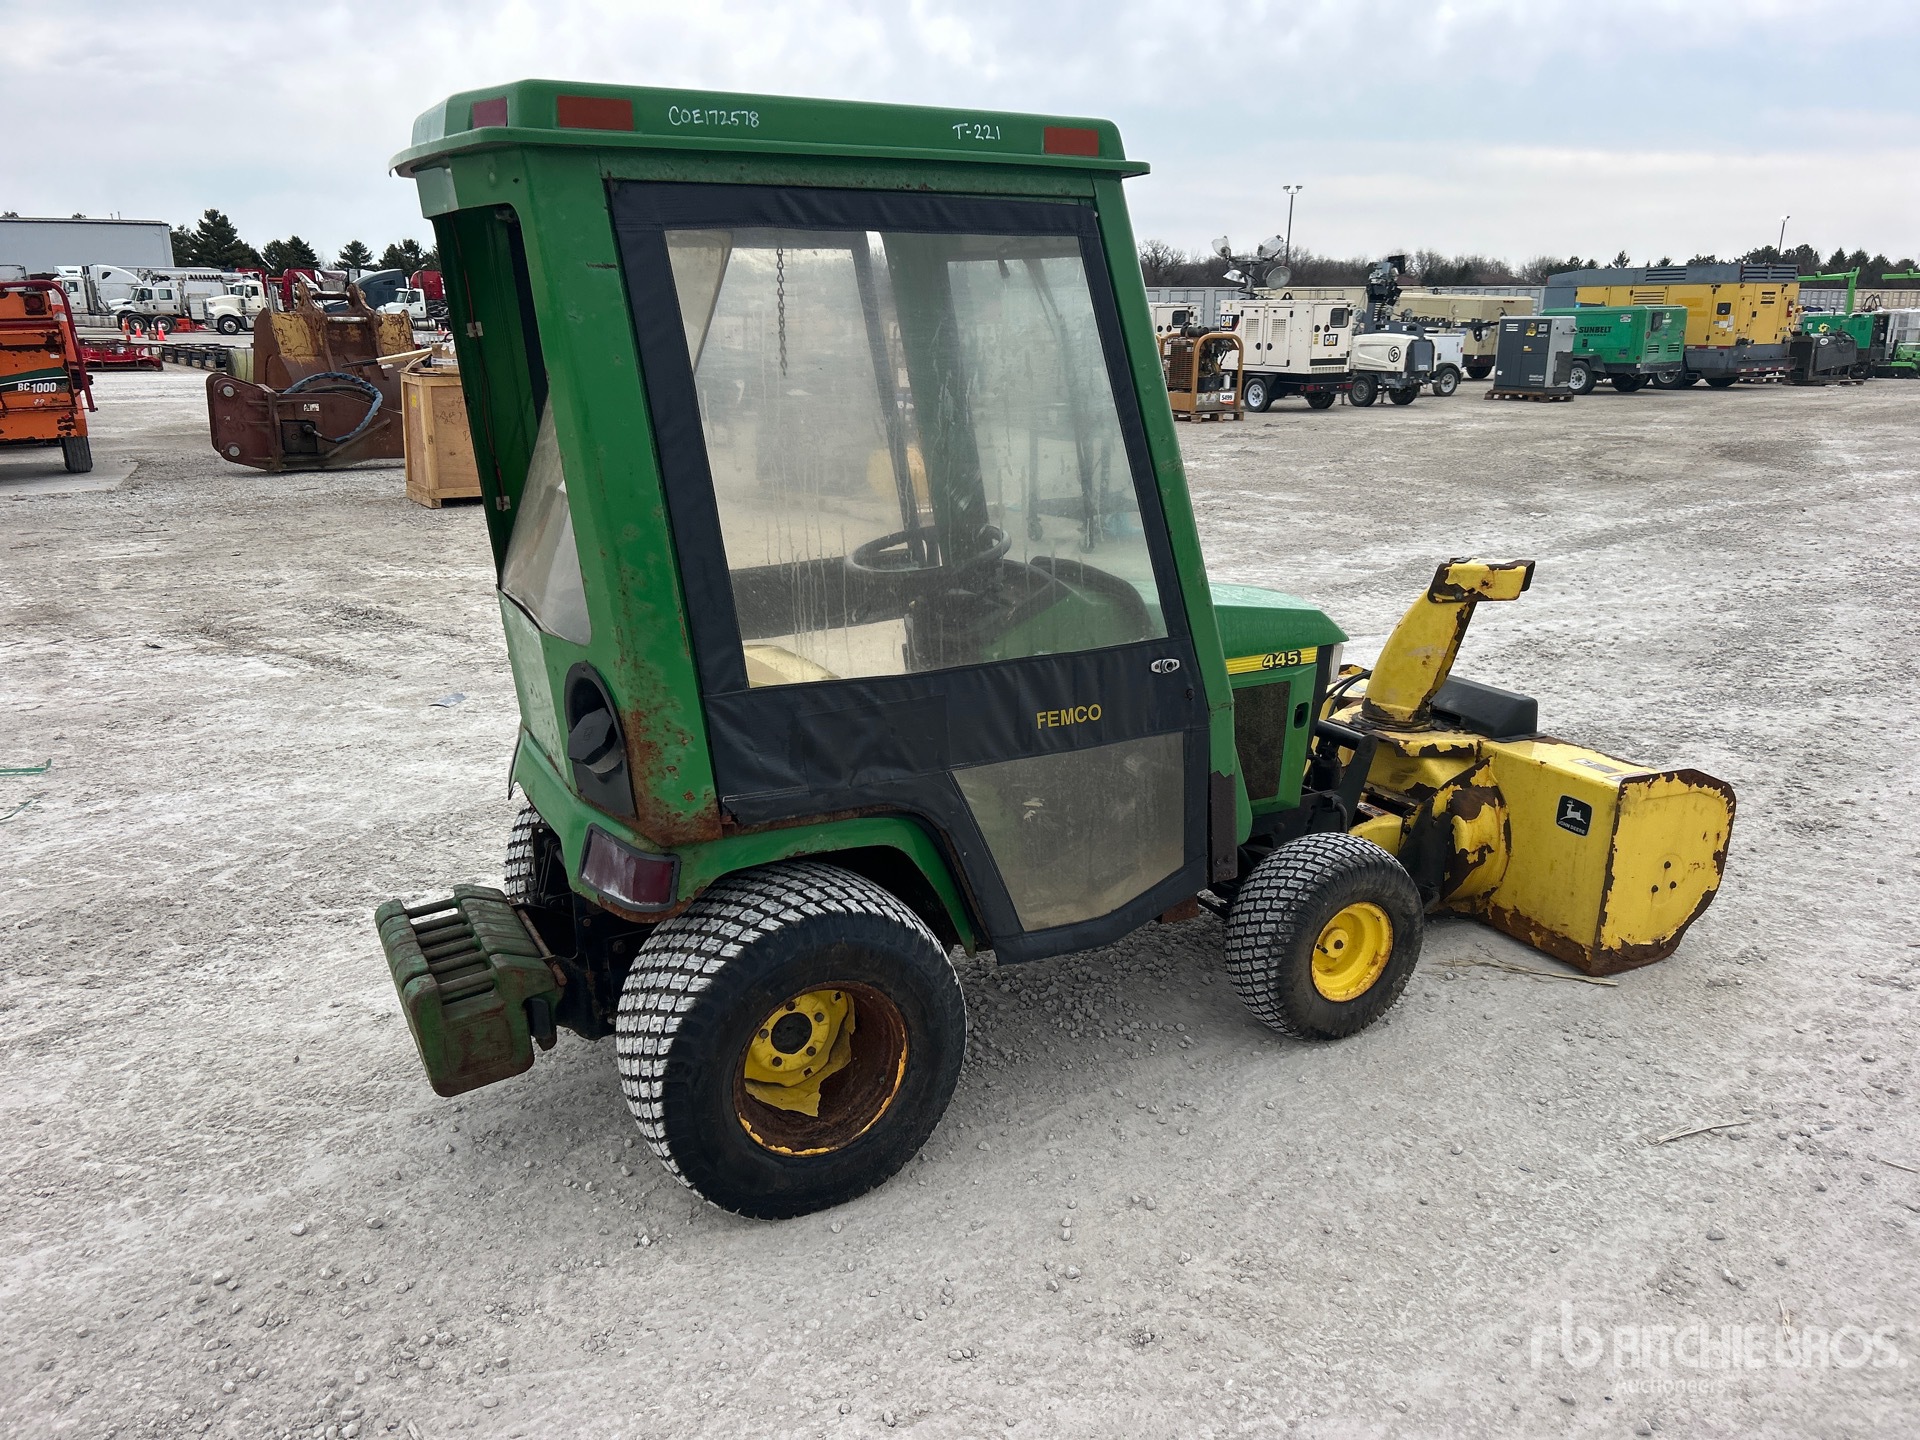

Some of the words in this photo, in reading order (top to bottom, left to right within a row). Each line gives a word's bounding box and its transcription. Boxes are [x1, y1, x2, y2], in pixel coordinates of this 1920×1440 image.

[952, 122, 1001, 140] T-221
[1221, 315, 1233, 326] CAT
[1324, 335, 1337, 345] CAT
[1261, 650, 1302, 669] 445
[1036, 703, 1102, 729] FEMCO
[1570, 824, 1586, 835] DEERE
